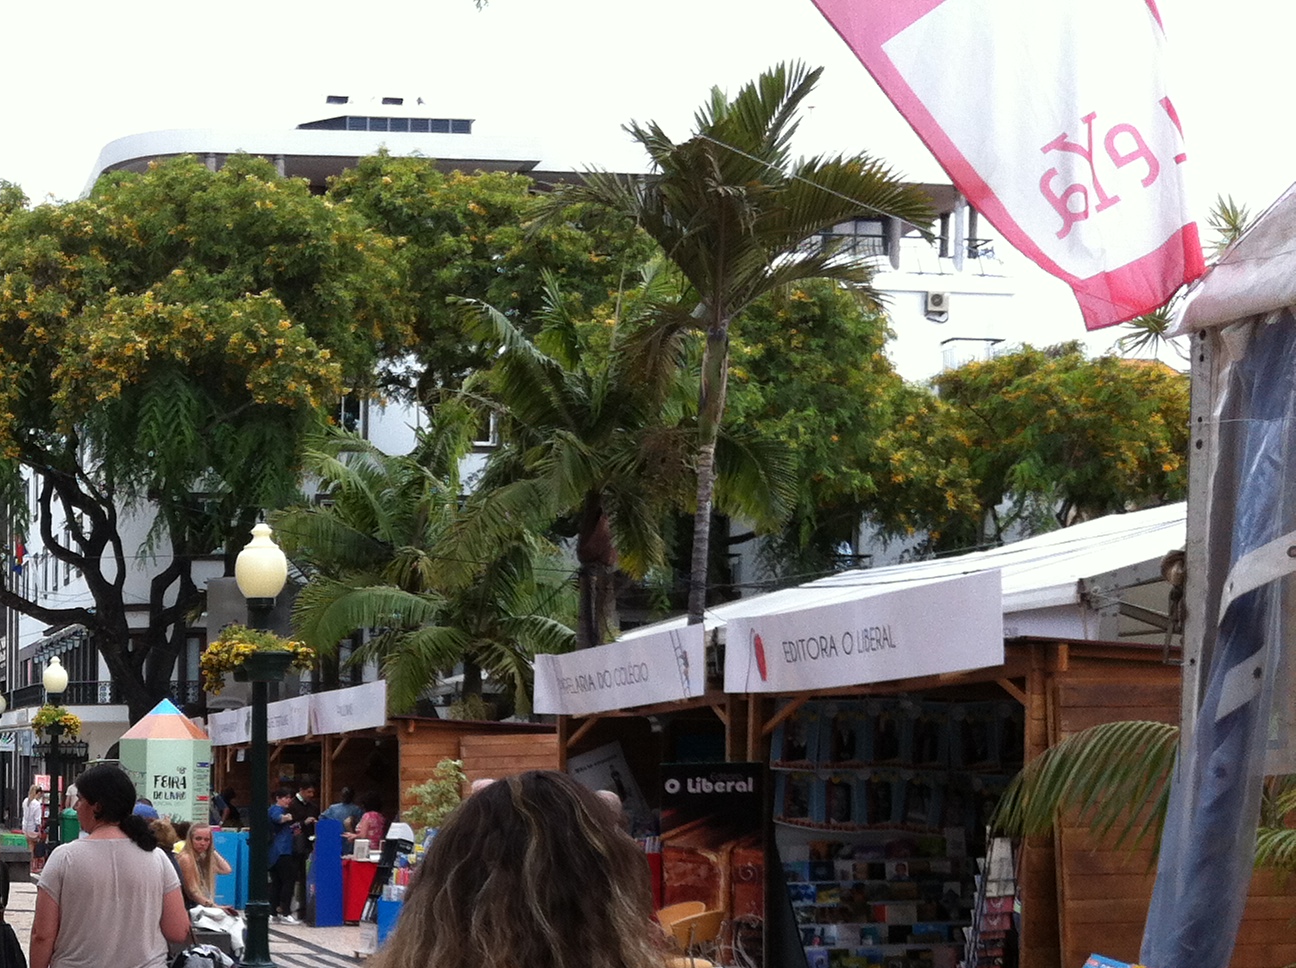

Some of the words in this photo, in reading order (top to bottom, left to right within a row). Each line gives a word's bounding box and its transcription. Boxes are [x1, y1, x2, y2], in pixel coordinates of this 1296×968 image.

[782, 634, 837, 664] EDITORA
[841, 630, 854, 656] O
[856, 623, 897, 654] LIBERAL
[597, 668, 612, 690] DO
[153, 774, 187, 790] FEIRA
[664, 778, 681, 795] O
[686, 776, 754, 794] Liberal
[153, 790, 163, 800] DO
[164, 791, 186, 800] LIVRO
